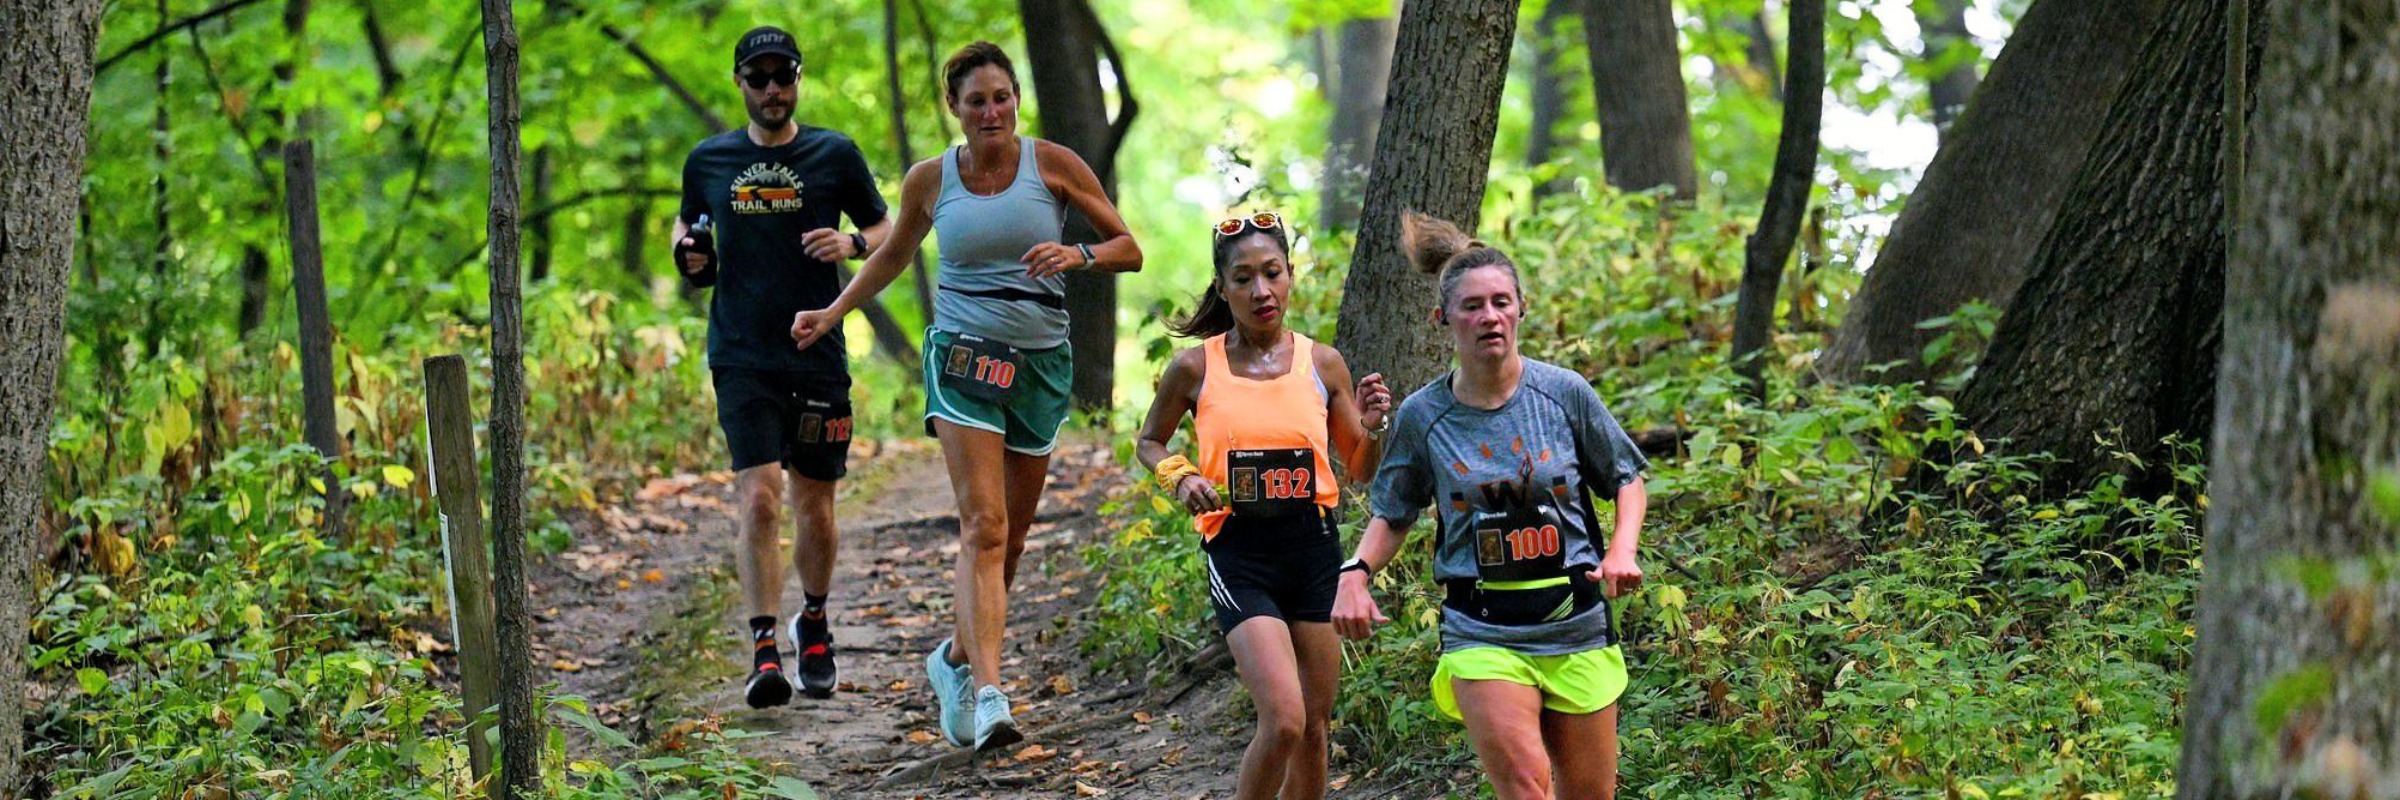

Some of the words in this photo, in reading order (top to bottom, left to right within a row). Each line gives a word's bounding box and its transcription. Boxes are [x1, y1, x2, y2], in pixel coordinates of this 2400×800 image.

[730, 162, 767, 192] SILVER
[772, 161, 804, 190] FALLS
[730, 200, 767, 211] TRAIL
[771, 197, 803, 210] RUNS
[975, 355, 1016, 389] 110
[1260, 467, 1311, 499] 132
[1505, 524, 1560, 560] 100
